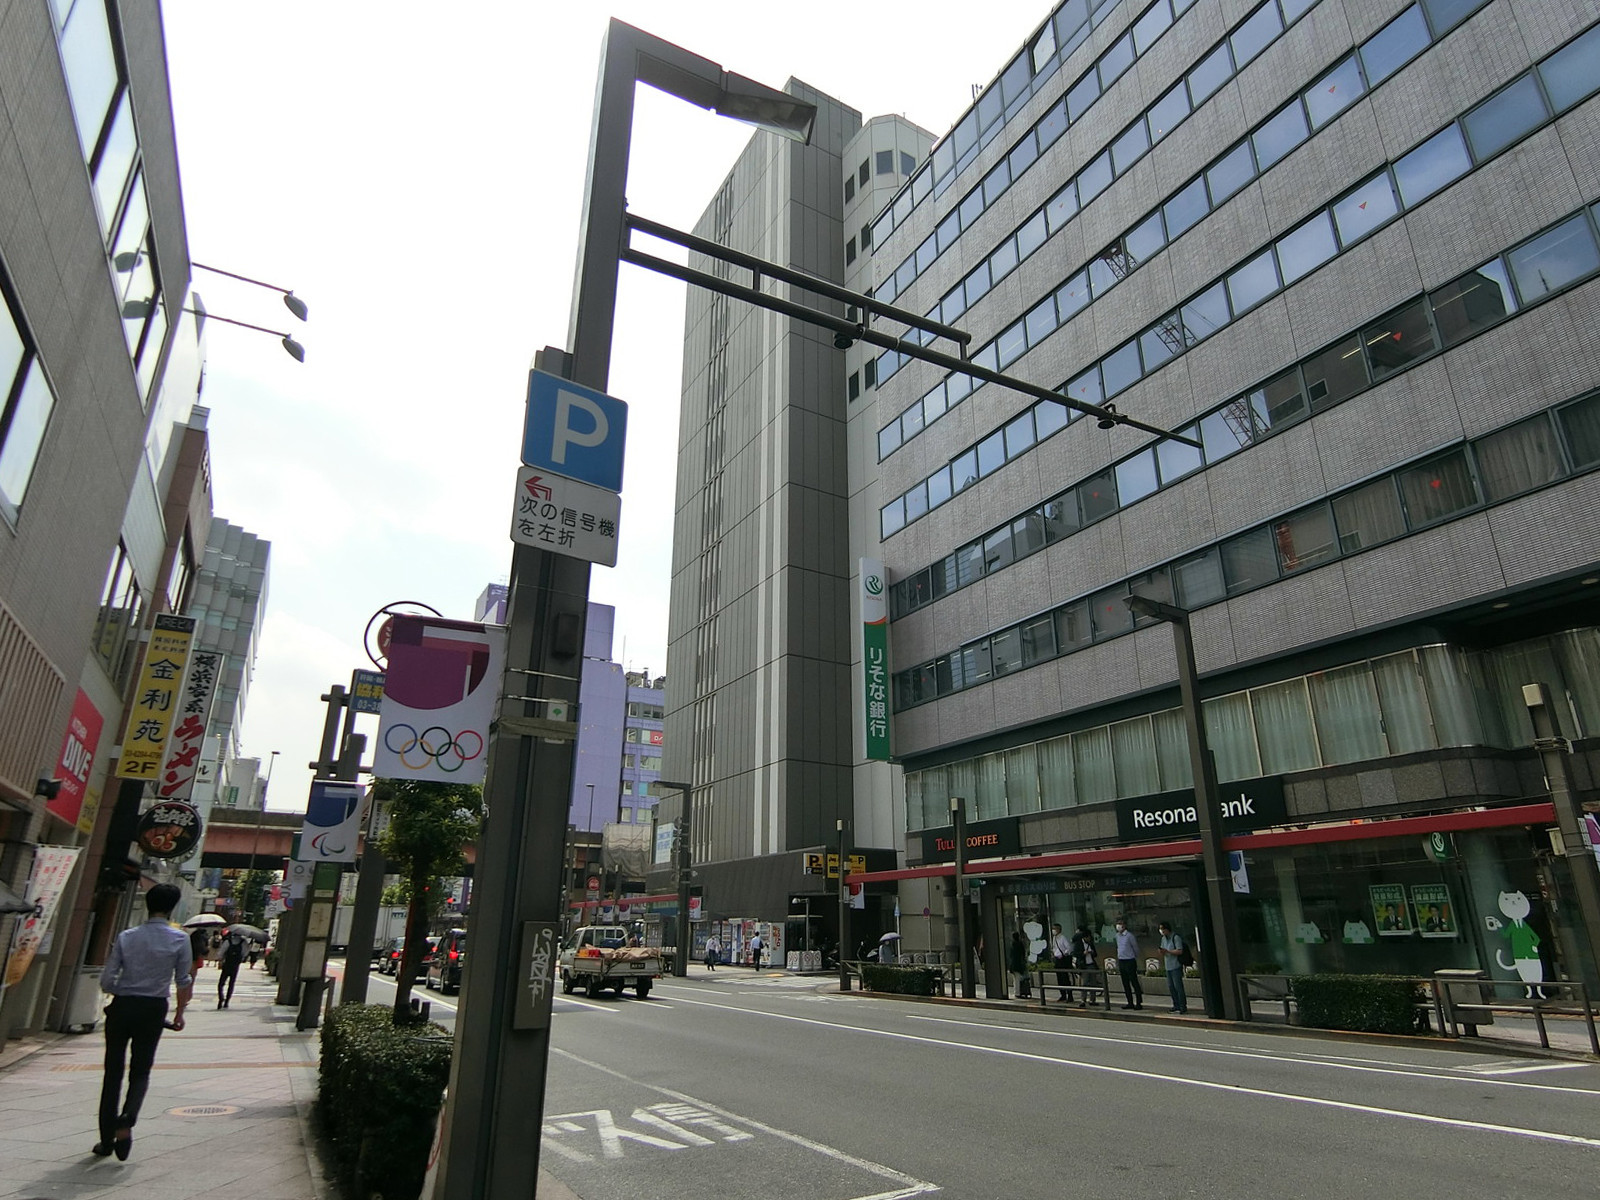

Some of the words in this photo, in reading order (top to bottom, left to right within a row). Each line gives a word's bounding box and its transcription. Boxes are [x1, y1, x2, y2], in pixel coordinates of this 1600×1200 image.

[550, 388, 610, 465] P
[516, 517, 576, 549] を左折
[518, 495, 616, 540] 次の信号機
[133, 658, 181, 743] 金利苑
[867, 644, 887, 739] りそな銀行
[62, 735, 92, 783] DIVE
[124, 760, 157, 774] 2F
[1133, 805, 1197, 829] Resona
[1220, 792, 1256, 818] ank
[809, 855, 820, 867] P
[935, 837, 956, 852] TULL
[966, 834, 999, 848] COFFEE
[1063, 881, 1078, 891] BUS
[1078, 879, 1096, 890] STOP
